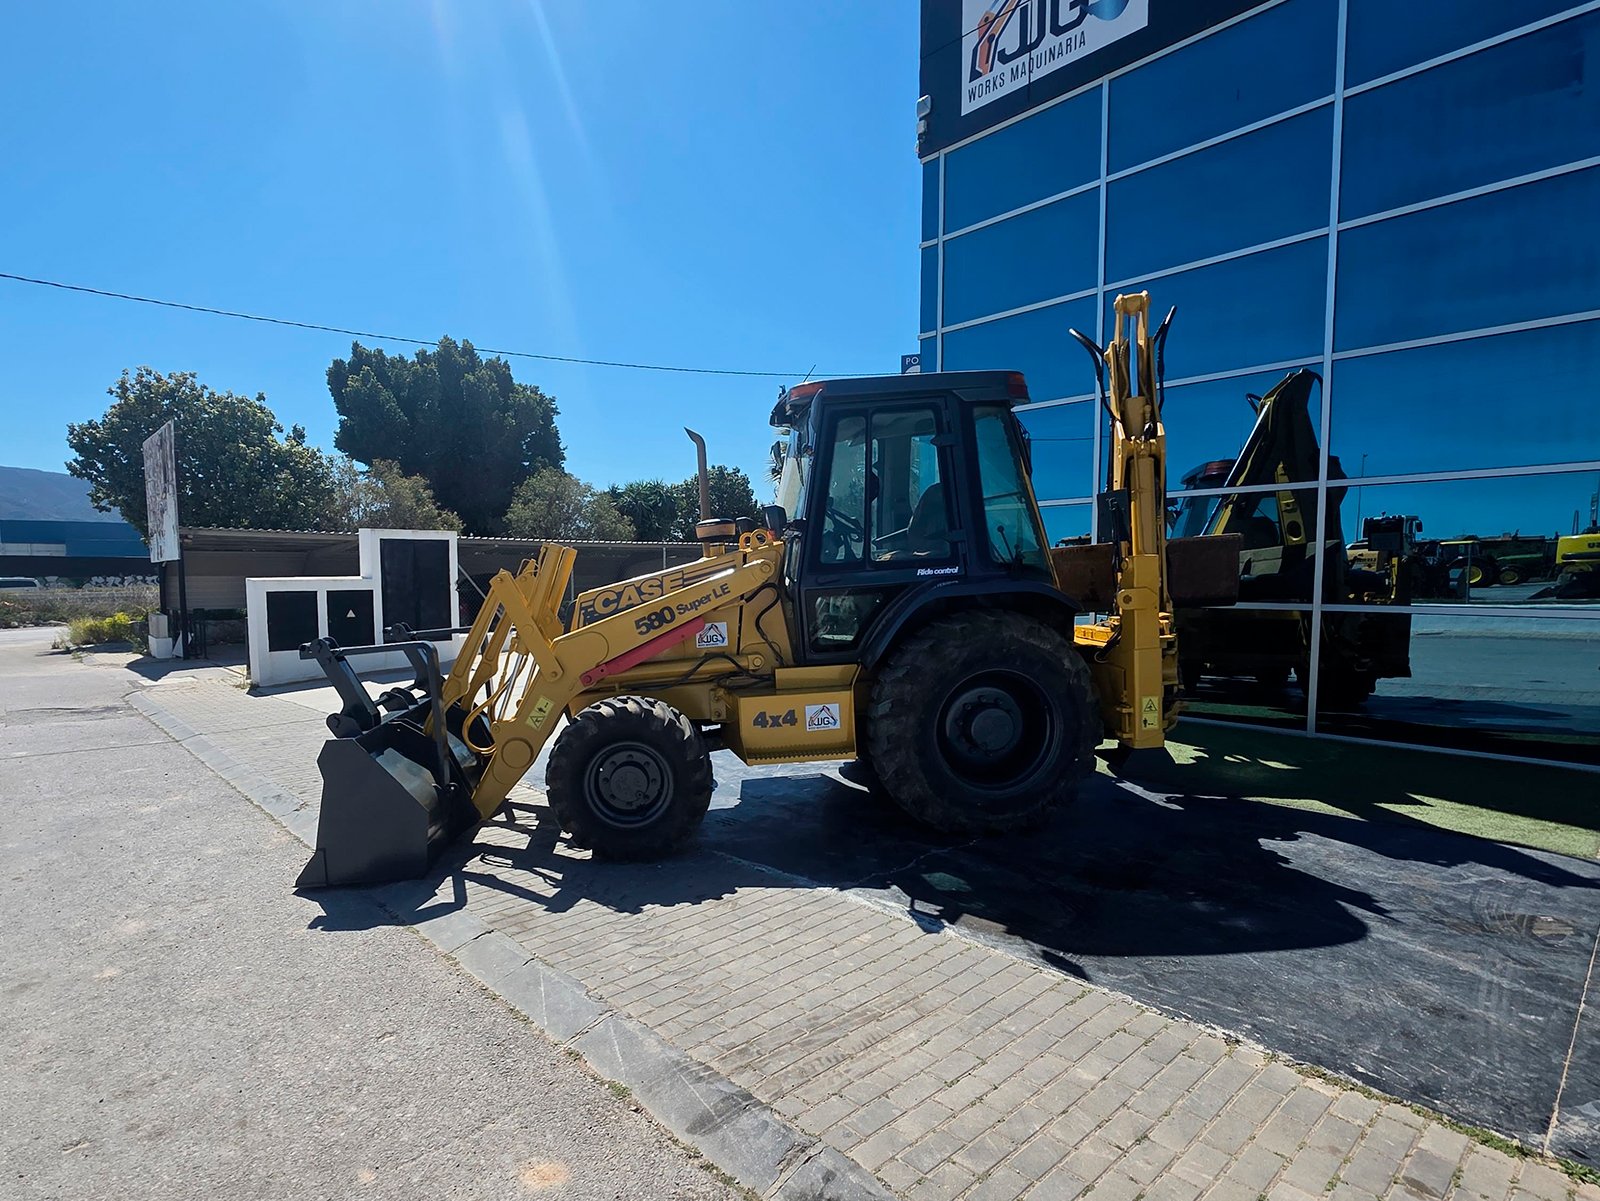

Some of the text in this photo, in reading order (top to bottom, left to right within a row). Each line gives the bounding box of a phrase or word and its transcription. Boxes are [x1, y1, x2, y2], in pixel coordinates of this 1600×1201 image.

[967, 30, 1086, 103] WORKS MAQUINARIA
[593, 570, 685, 615] CASE
[917, 566, 959, 576] Ride control
[634, 582, 731, 636] 580 Super LE
[752, 709, 798, 729] 4x4
